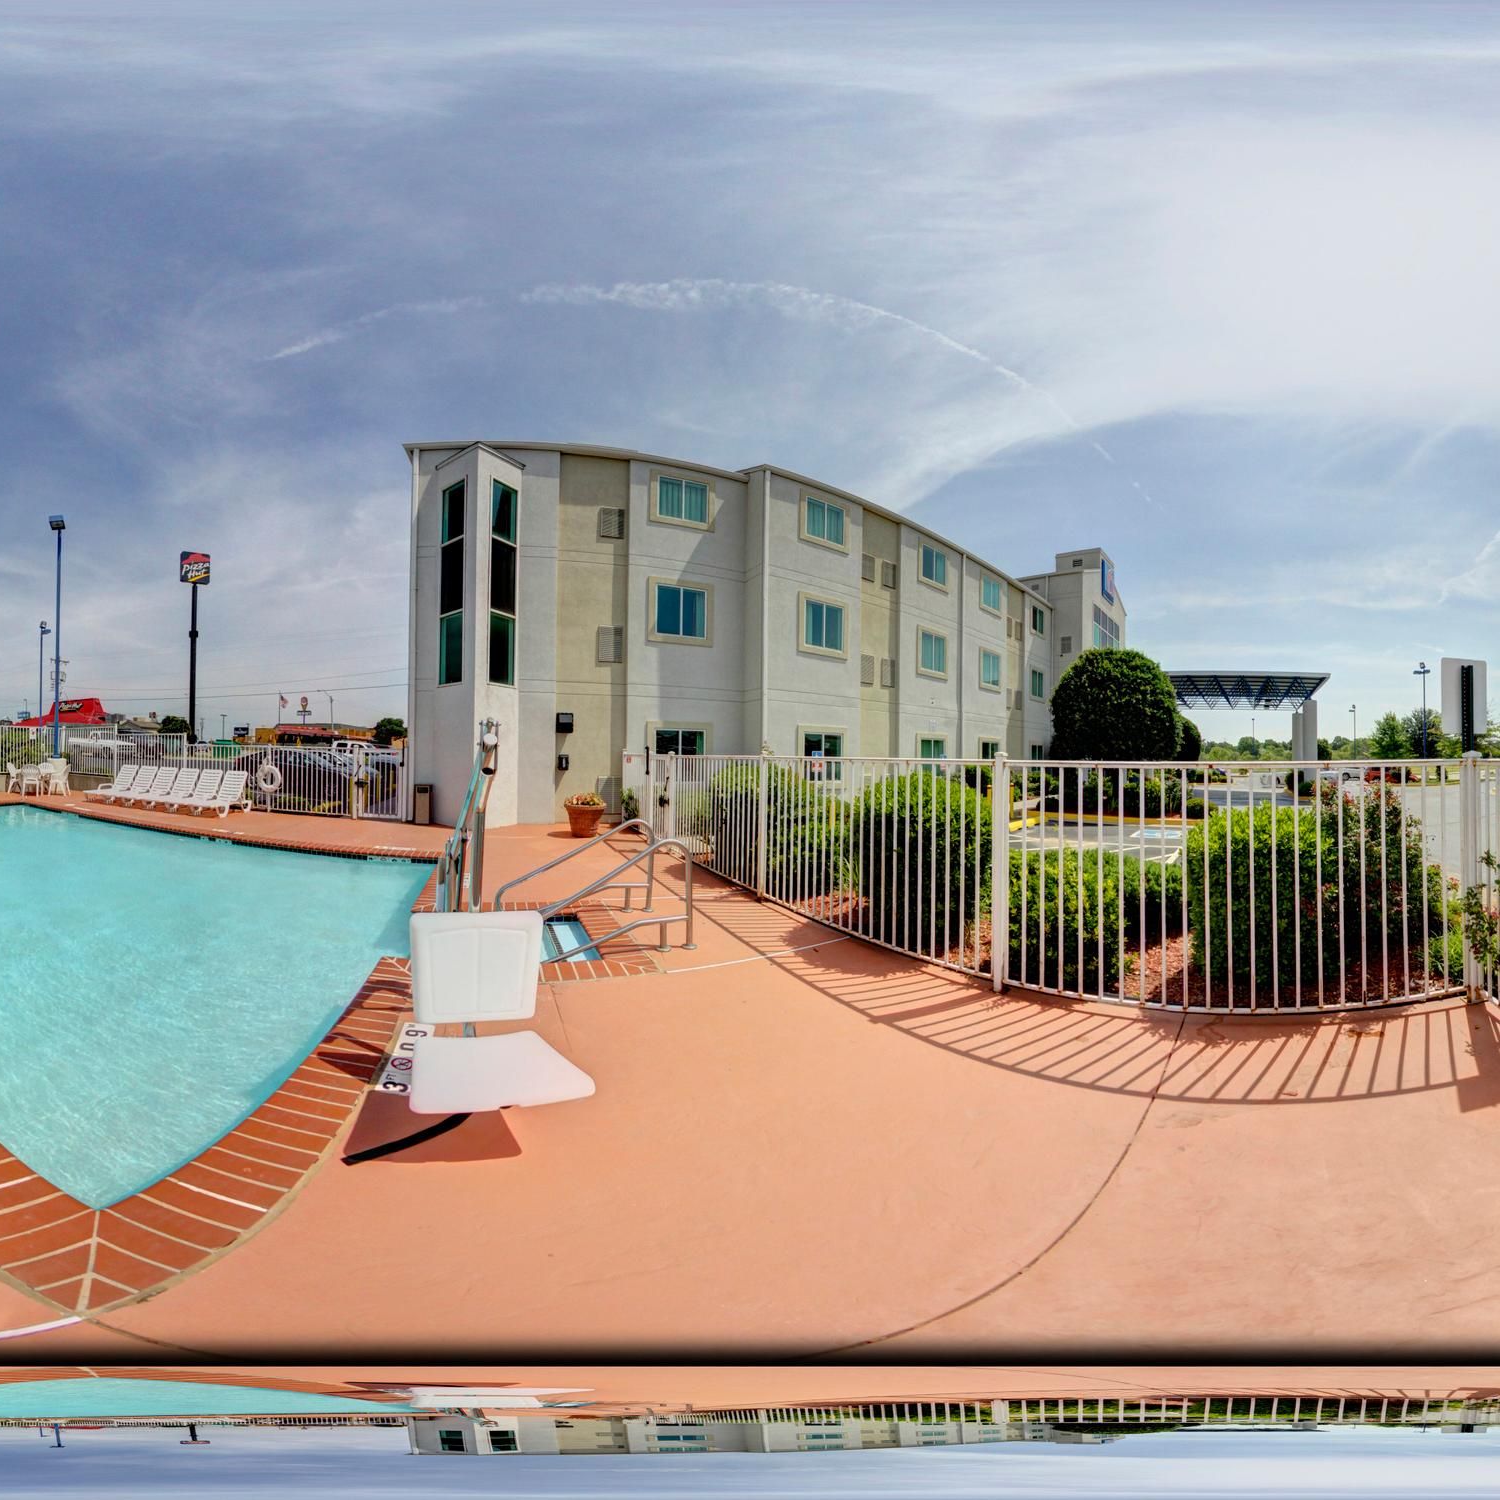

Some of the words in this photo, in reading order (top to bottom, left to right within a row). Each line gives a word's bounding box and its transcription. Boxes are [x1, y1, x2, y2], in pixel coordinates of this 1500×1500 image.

[182, 561, 210, 575] Pizza
[188, 569, 208, 579] Hut
[383, 1081, 408, 1093] 3
